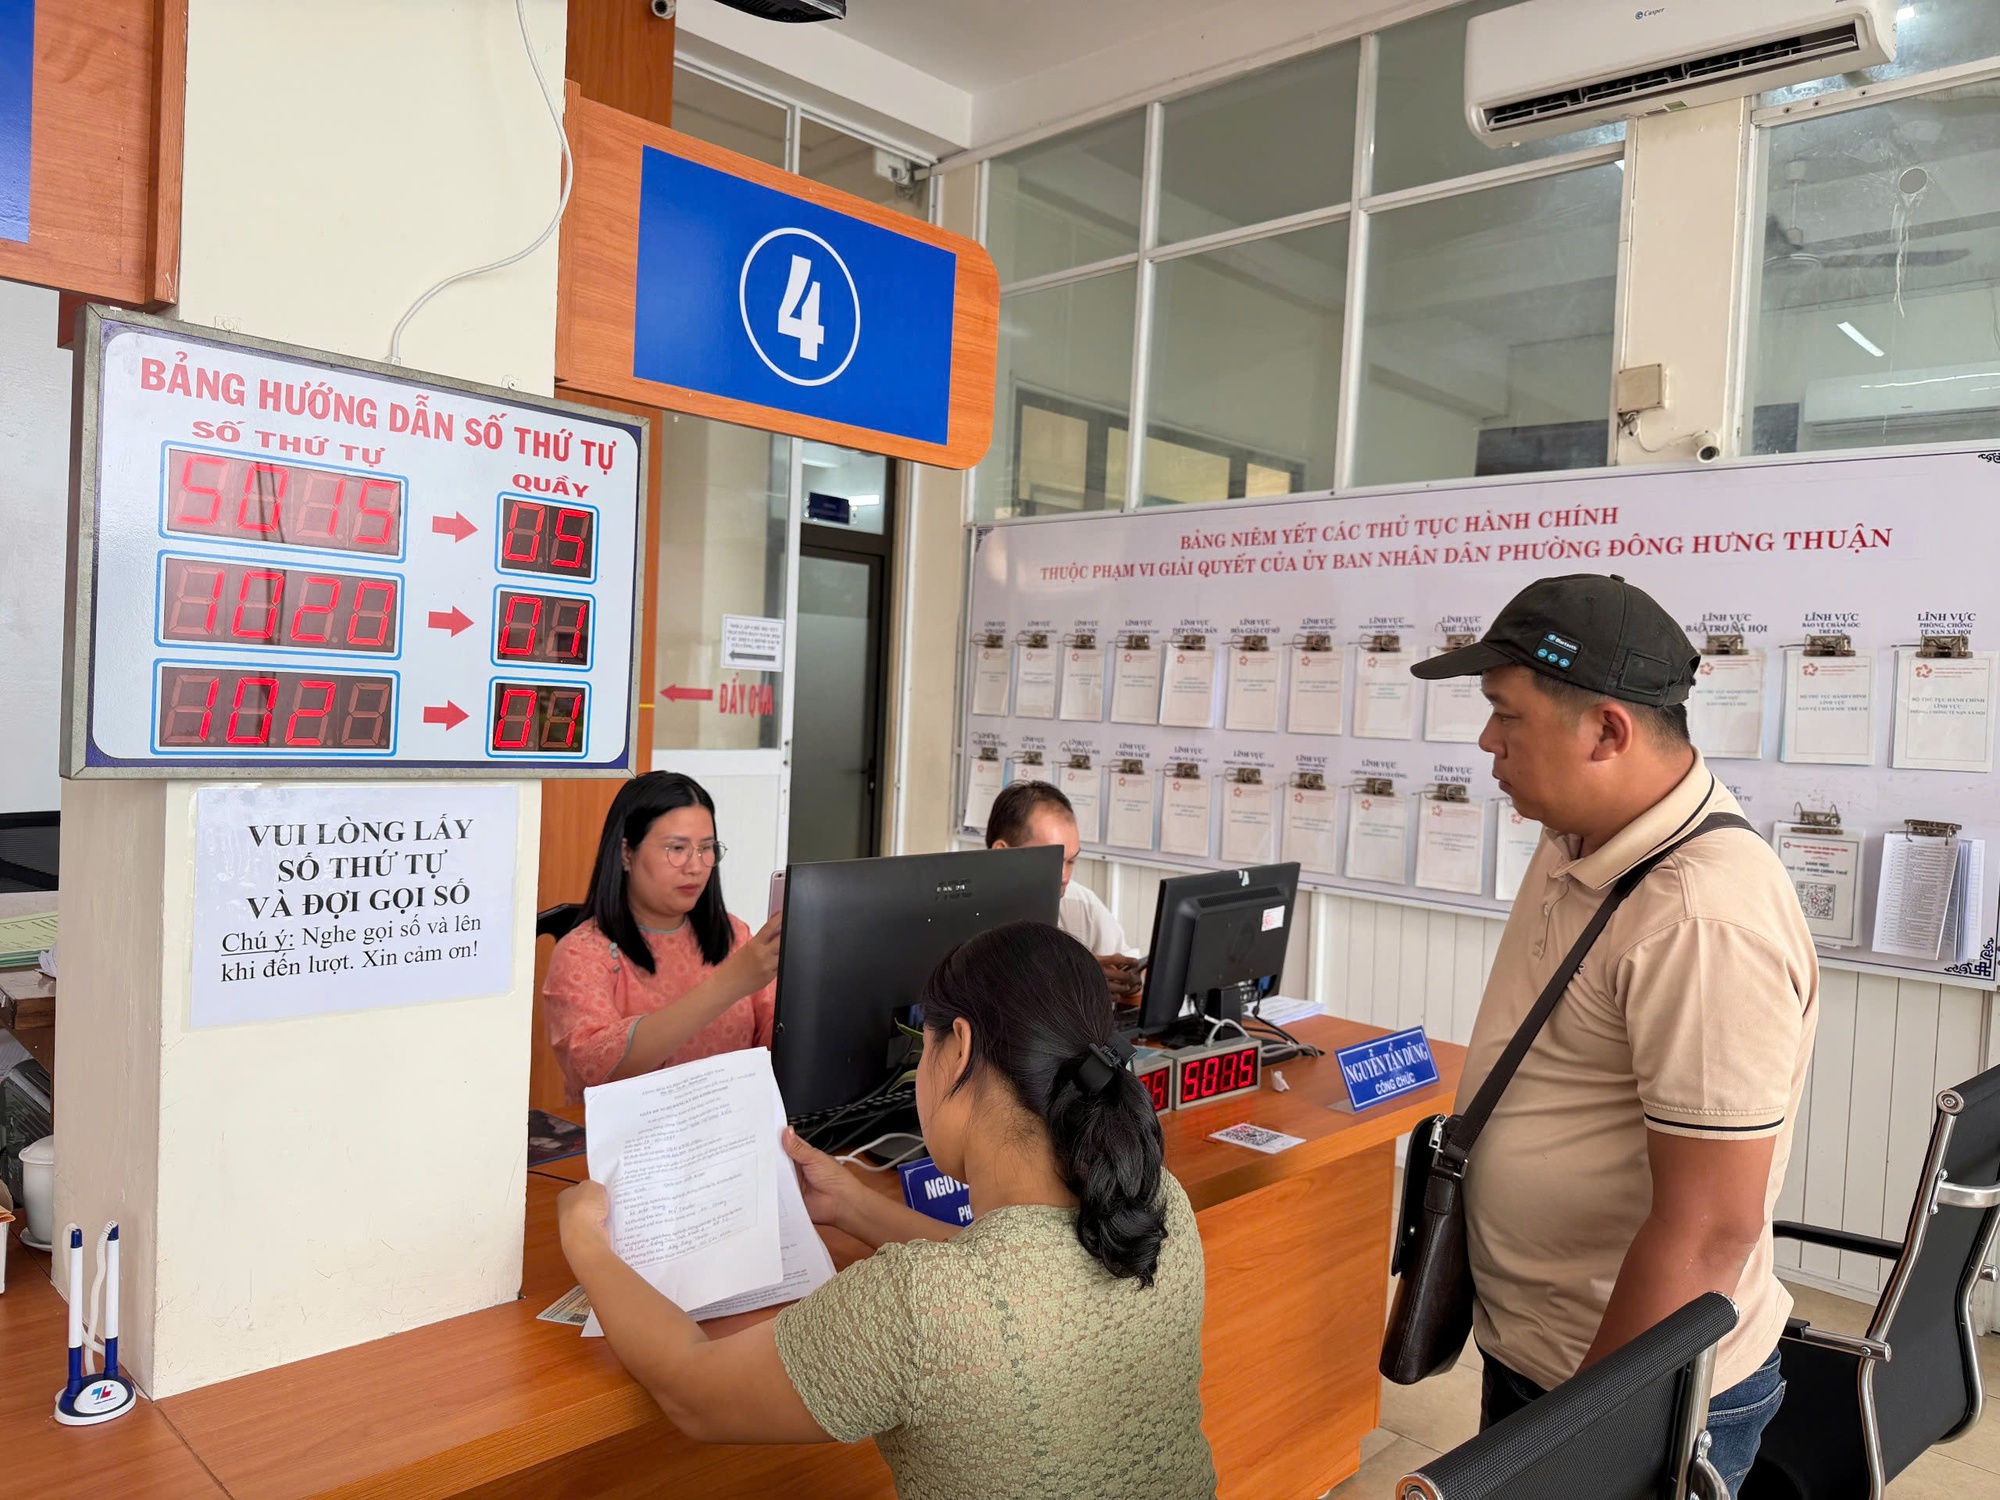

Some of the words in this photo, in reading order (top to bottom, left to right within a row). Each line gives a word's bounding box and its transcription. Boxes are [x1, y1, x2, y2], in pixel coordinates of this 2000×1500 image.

[1643, 7, 1665, 16] Casper
[777, 254, 824, 361] 4
[141, 351, 246, 407] BẢNG
[258, 379, 378, 429] HƯỚNG
[389, 394, 454, 442] DẪN
[464, 413, 507, 451] SỐ
[514, 428, 574, 462] THỨ
[581, 440, 618, 475] TỰ
[191, 420, 246, 443] SỐ
[255, 430, 330, 456] THỨ
[339, 443, 386, 467] TỰ
[174, 454, 401, 545] 5015
[512, 474, 590, 498] QUẦY
[502, 502, 588, 569] 05
[1180, 529, 1226, 550] BẢNG
[1231, 527, 1277, 548] NIÊM
[1283, 522, 1317, 544] YẾT
[1322, 521, 1361, 542] CÁC
[1366, 514, 1409, 539] THỦ
[1415, 518, 1458, 539] TỤC
[1464, 509, 1531, 533] HÀNH
[1538, 504, 1619, 527] CHÍNH
[1041, 563, 1088, 582] THUỘC
[1092, 564, 1135, 581] PHẠM
[1140, 563, 1154, 577] VI
[1159, 557, 1194, 576] GIẢI
[1198, 553, 1256, 578] QUYẾT
[1261, 551, 1298, 573] CỦA
[1303, 549, 1327, 571] ỦY
[1332, 552, 1372, 570] BAN
[1377, 545, 1437, 568] NHÂN
[1443, 541, 1490, 564] DÂN
[1496, 536, 1600, 562] PHƯỜNG
[1606, 532, 1684, 558] ĐÔNG
[1692, 531, 1775, 554] HƯNG
[1783, 523, 1893, 554] THUẬN
[204, 568, 396, 646] 1020
[500, 595, 587, 658] 01
[1442, 615, 1462, 624] LĨNH
[1463, 615, 1481, 624] VỰC
[1702, 613, 1727, 622] LĨNH
[1729, 613, 1753, 623] VỰC
[1805, 612, 1832, 621] LĨNH
[1834, 613, 1859, 623] VỰC
[1917, 611, 1946, 621] LĨNH
[1950, 611, 1976, 623] VỰC
[1555, 637, 1577, 651] Bluetooth
[1709, 623, 1729, 633] TRỢ
[1748, 624, 1767, 634] HỘI
[200, 676, 336, 746] 102
[719, 672, 746, 715] ĐẨY
[493, 688, 582, 748] 01
[1361, 759, 1379, 769] LĨNH
[1380, 759, 1397, 769] VỰC
[1434, 764, 1454, 774] LĨNH
[1455, 764, 1473, 774] VỰC
[248, 823, 307, 847] VUI
[316, 816, 405, 845] LÒNG
[412, 813, 474, 841] LẤY
[278, 852, 320, 883] SỐ
[329, 850, 399, 879] THỨ
[405, 849, 448, 880] TỰ
[246, 889, 293, 920] VÀ
[302, 888, 361, 920] ĐỢI
[369, 887, 425, 914] GỌI
[434, 878, 470, 907] SỐ
[221, 930, 267, 953] Chú
[275, 931, 295, 952] ý:
[302, 926, 356, 950] Nghe
[363, 920, 394, 946] gọi
[400, 914, 420, 937] số
[427, 917, 448, 934] và
[454, 915, 481, 932] lên
[221, 961, 256, 982] khi
[263, 953, 300, 978] đến
[308, 954, 354, 976] lượt.
[361, 948, 398, 970] Xin
[404, 944, 442, 964] cảm
[448, 941, 478, 959] ơn!
[1345, 1049, 1388, 1085] NGUYỄN
[1383, 1042, 1406, 1071] TẤN
[1375, 1080, 1397, 1095] CÔNG
[1396, 1071, 1416, 1087] CHỨC
